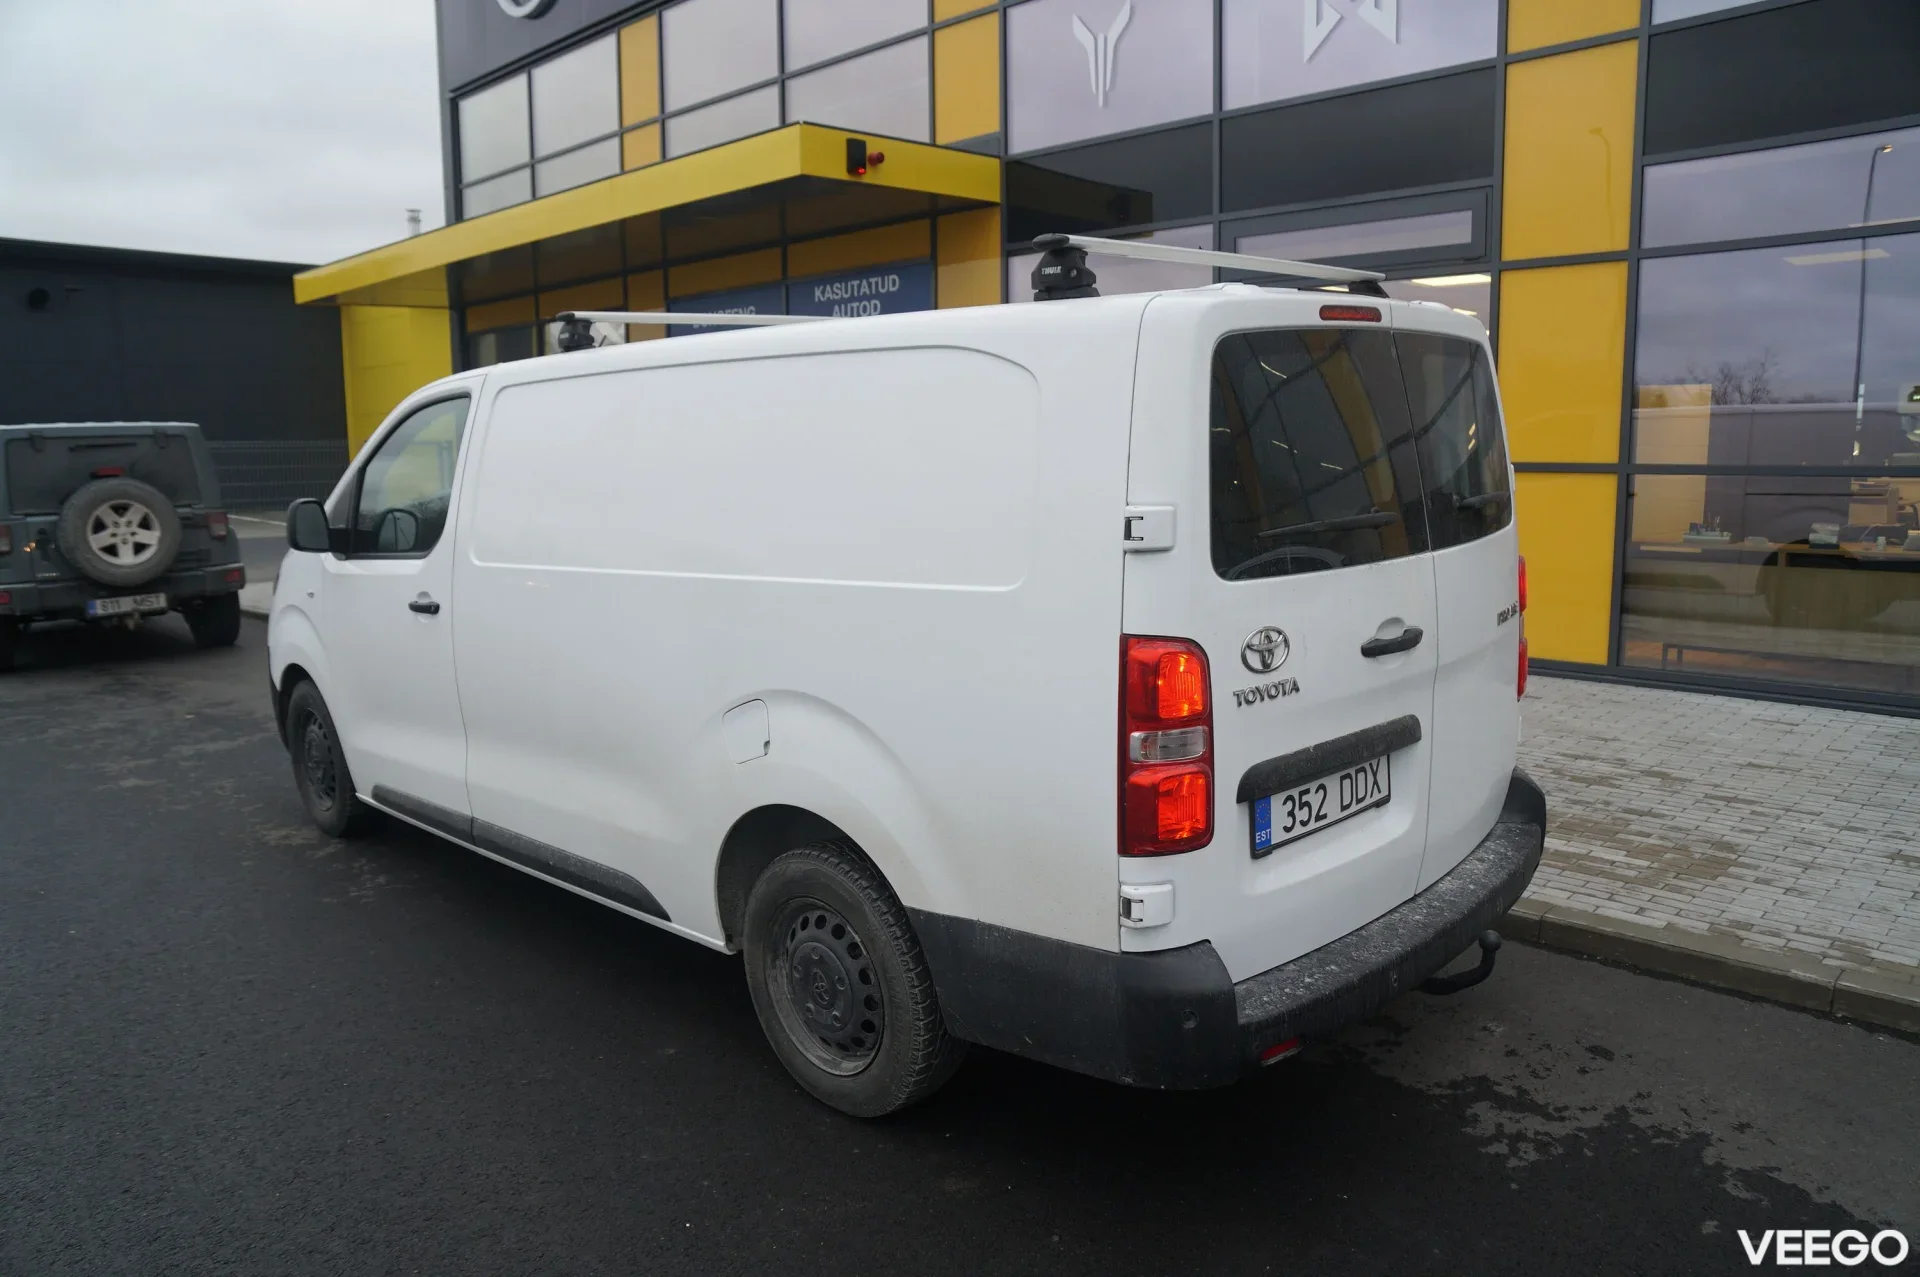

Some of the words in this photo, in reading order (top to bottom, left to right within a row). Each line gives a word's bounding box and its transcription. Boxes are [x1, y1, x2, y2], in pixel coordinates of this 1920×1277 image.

[1041, 266, 1062, 275] THULE
[814, 274, 900, 302] KASUTATUD
[832, 299, 881, 317] AUTOD
[1233, 676, 1300, 708] TOYOTA
[1282, 782, 1328, 834] 352
[1339, 757, 1382, 813] DDX
[1255, 828, 1271, 843] EST
